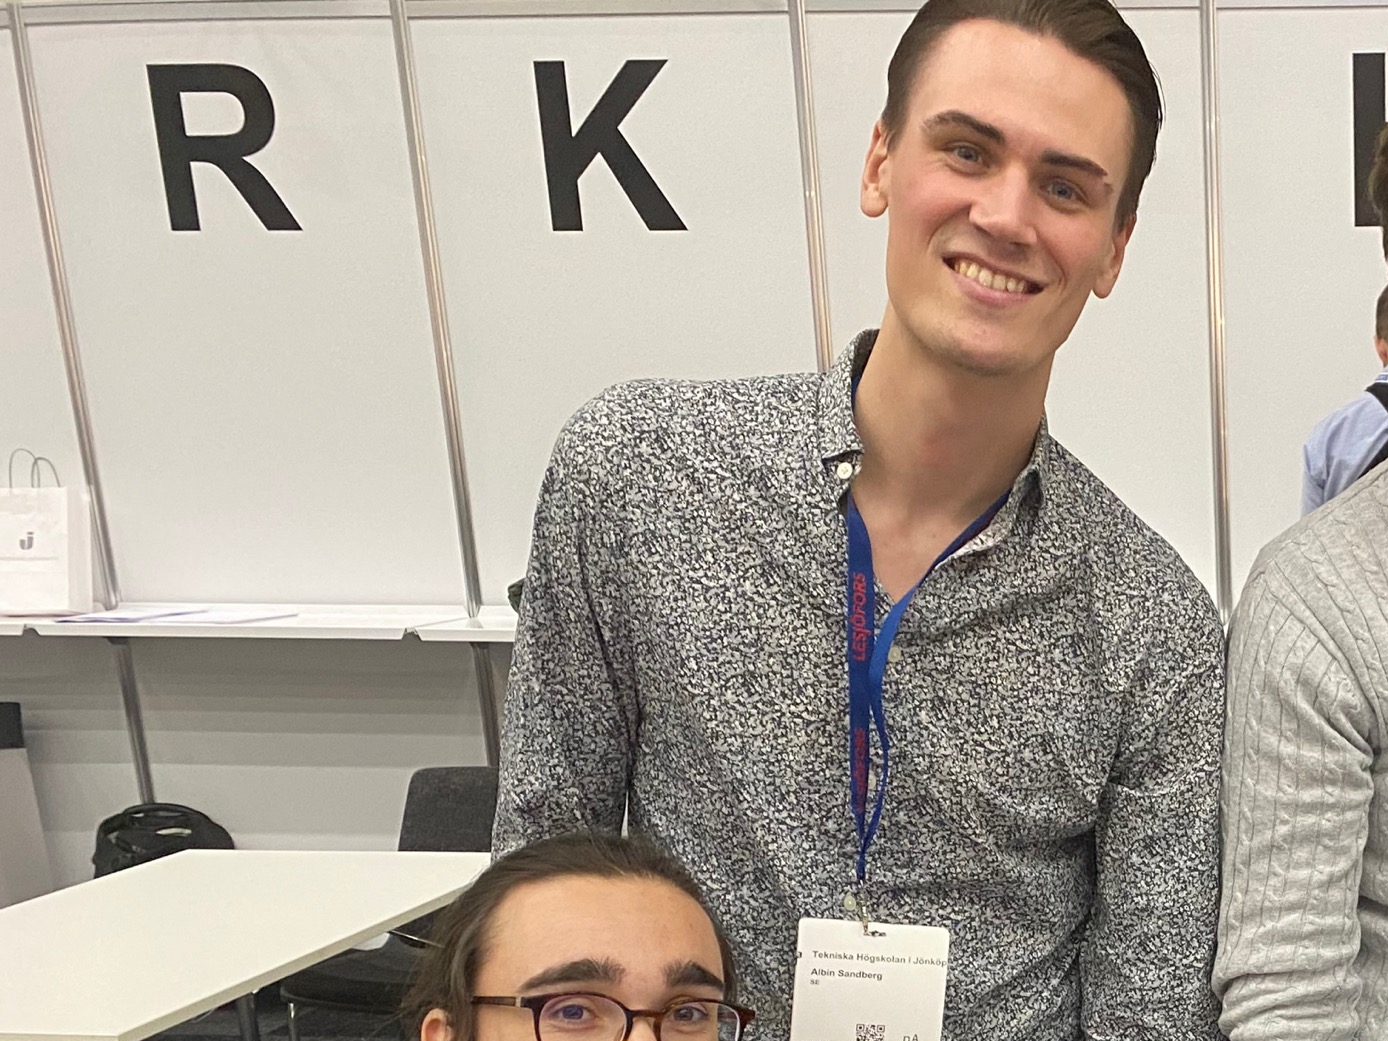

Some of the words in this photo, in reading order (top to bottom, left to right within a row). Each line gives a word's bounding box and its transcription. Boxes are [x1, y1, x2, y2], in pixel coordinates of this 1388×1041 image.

[146, 63, 303, 232] R
[534, 59, 688, 232] K
[812, 951, 854, 960] Tekniska
[856, 954, 906, 964] Högskolan
[811, 968, 835, 977] Albin
[838, 970, 883, 981] Sandberg
